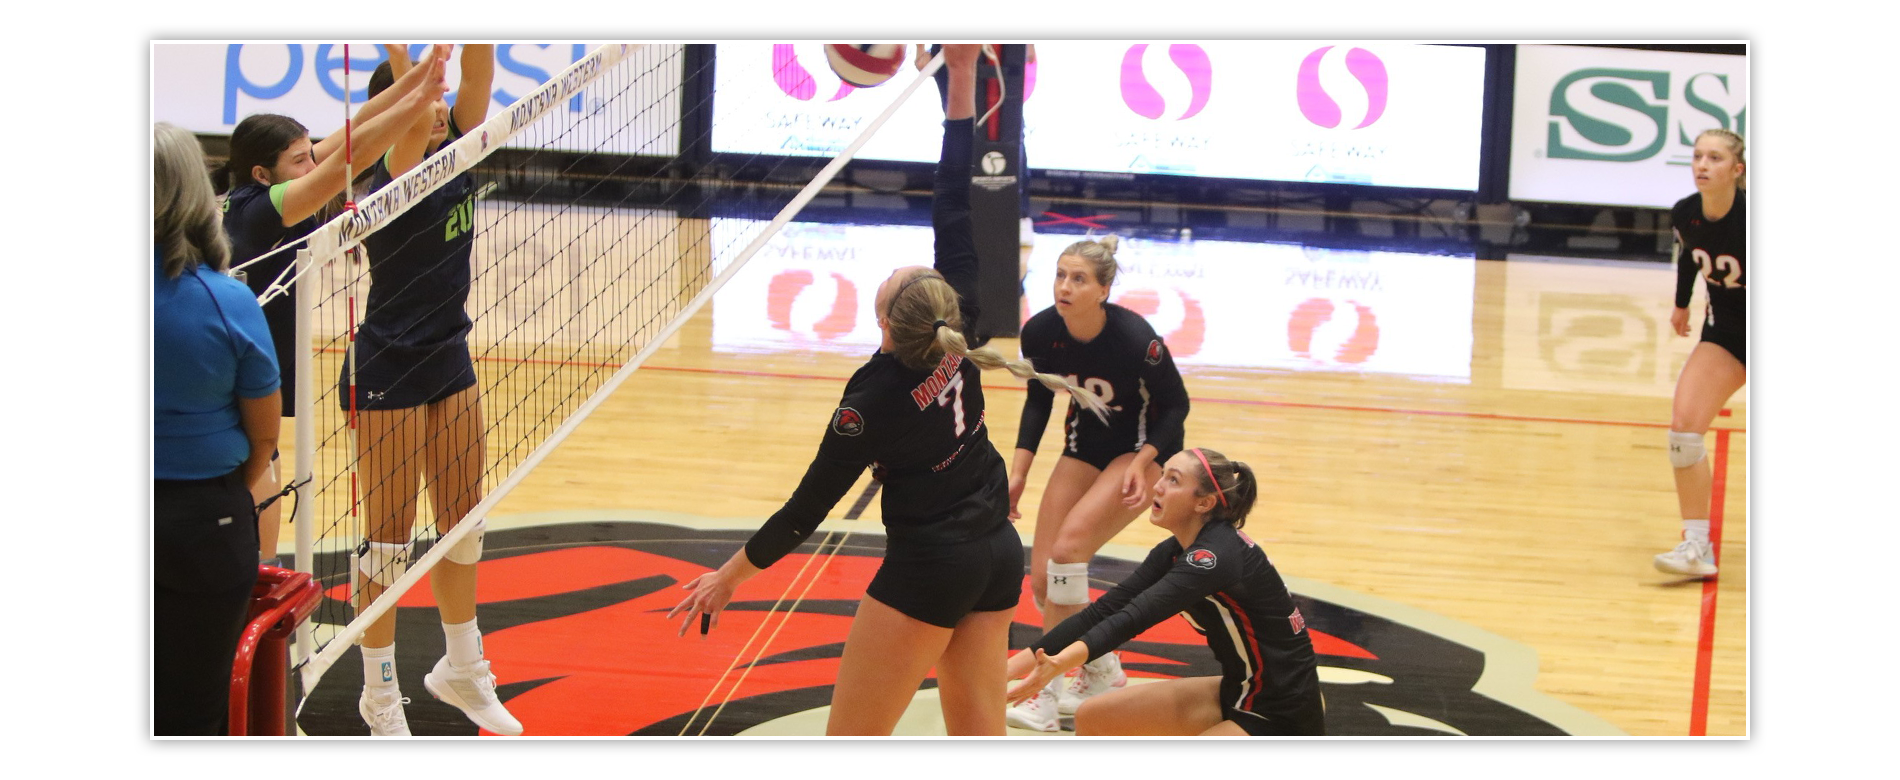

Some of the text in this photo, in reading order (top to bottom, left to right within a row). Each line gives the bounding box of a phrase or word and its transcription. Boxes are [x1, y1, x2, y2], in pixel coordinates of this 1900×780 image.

[510, 53, 602, 134] MONTANA WESTERN
[339, 149, 456, 247] MONTANA WESTERN
[445, 194, 474, 242] 20
[1691, 247, 1743, 289] 22
[911, 351, 966, 411] MONTA
[937, 371, 966, 438] 7
